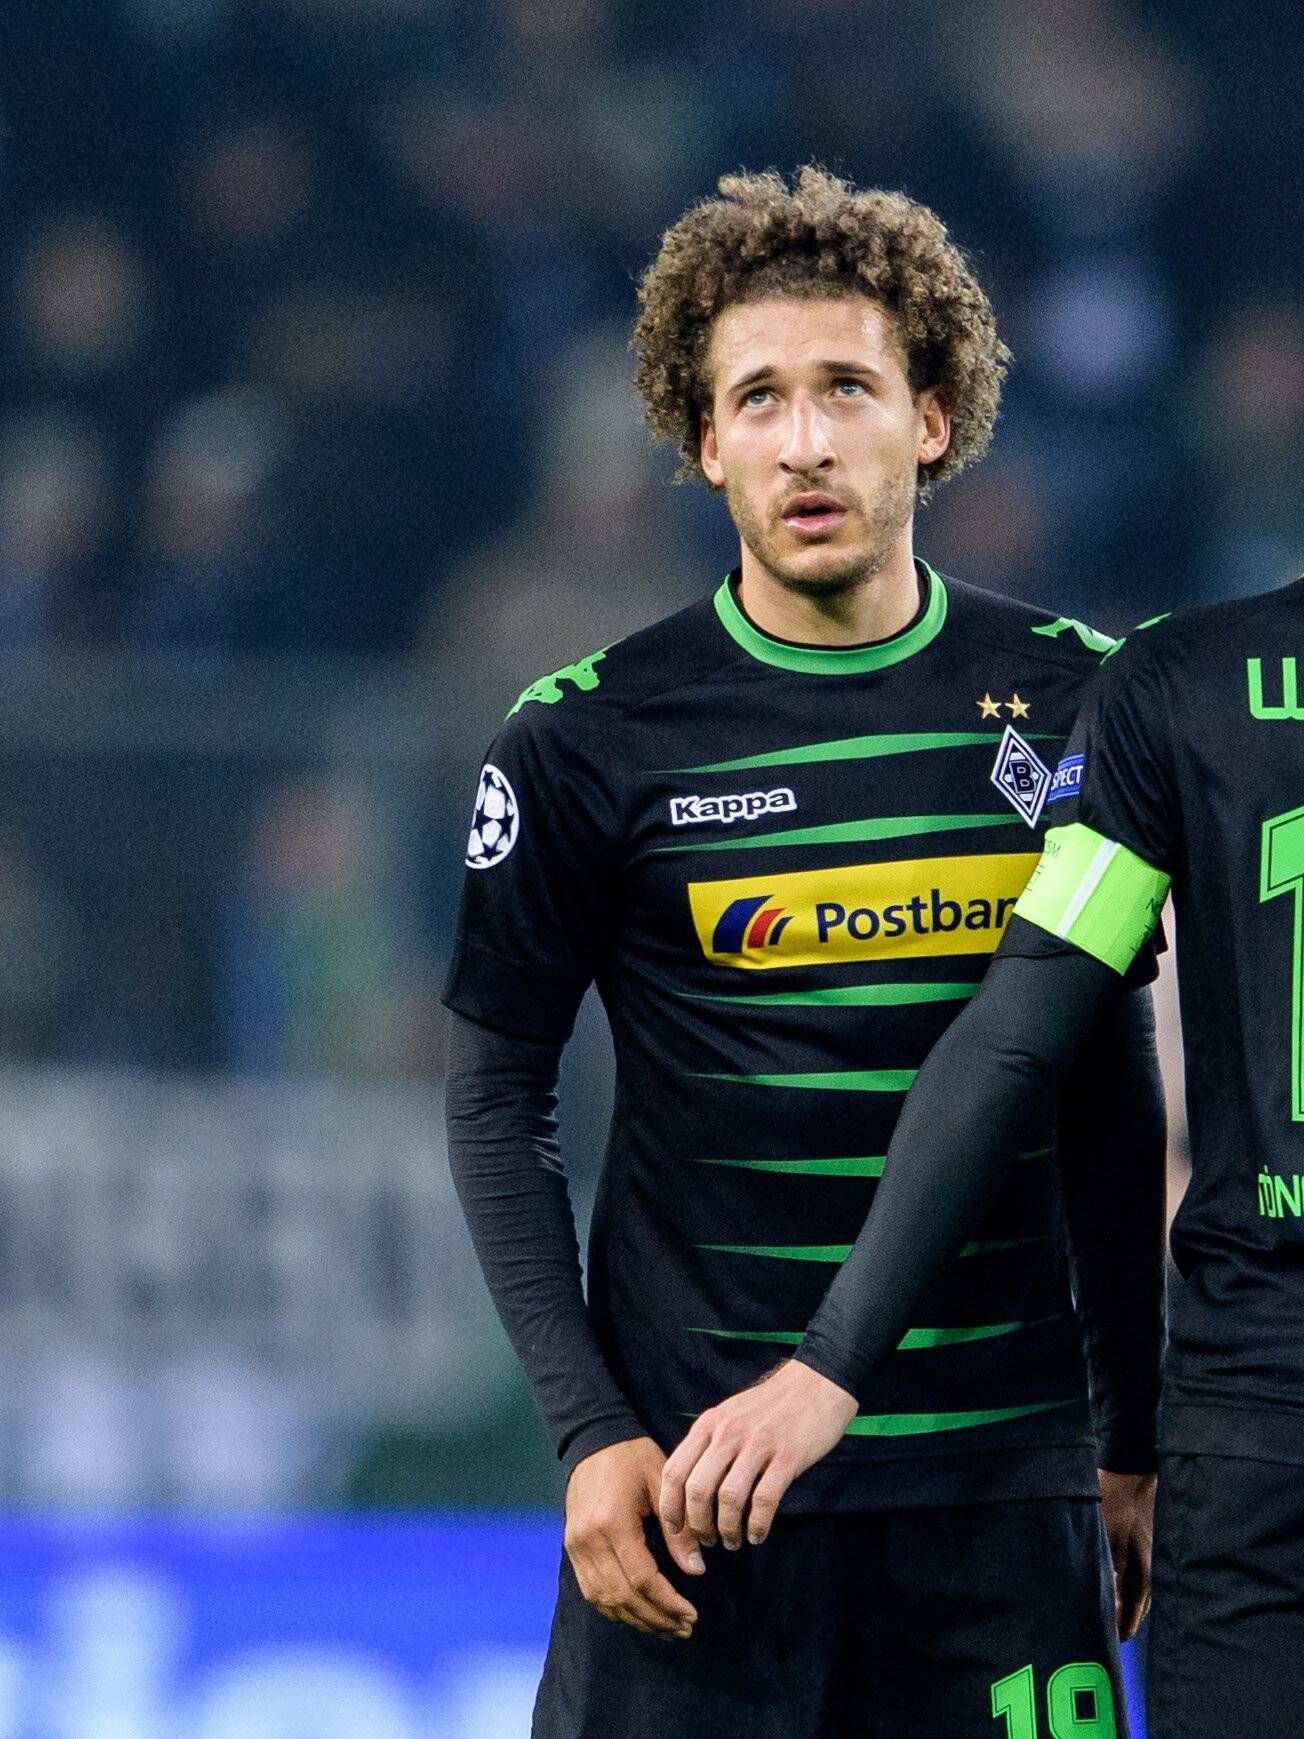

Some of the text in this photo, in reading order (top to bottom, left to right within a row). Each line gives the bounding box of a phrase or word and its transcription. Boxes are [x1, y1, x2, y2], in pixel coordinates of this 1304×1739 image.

[1051, 765, 1084, 790] SPECT
[670, 788, 797, 825] Kappa
[815, 888, 1018, 943] Postban
